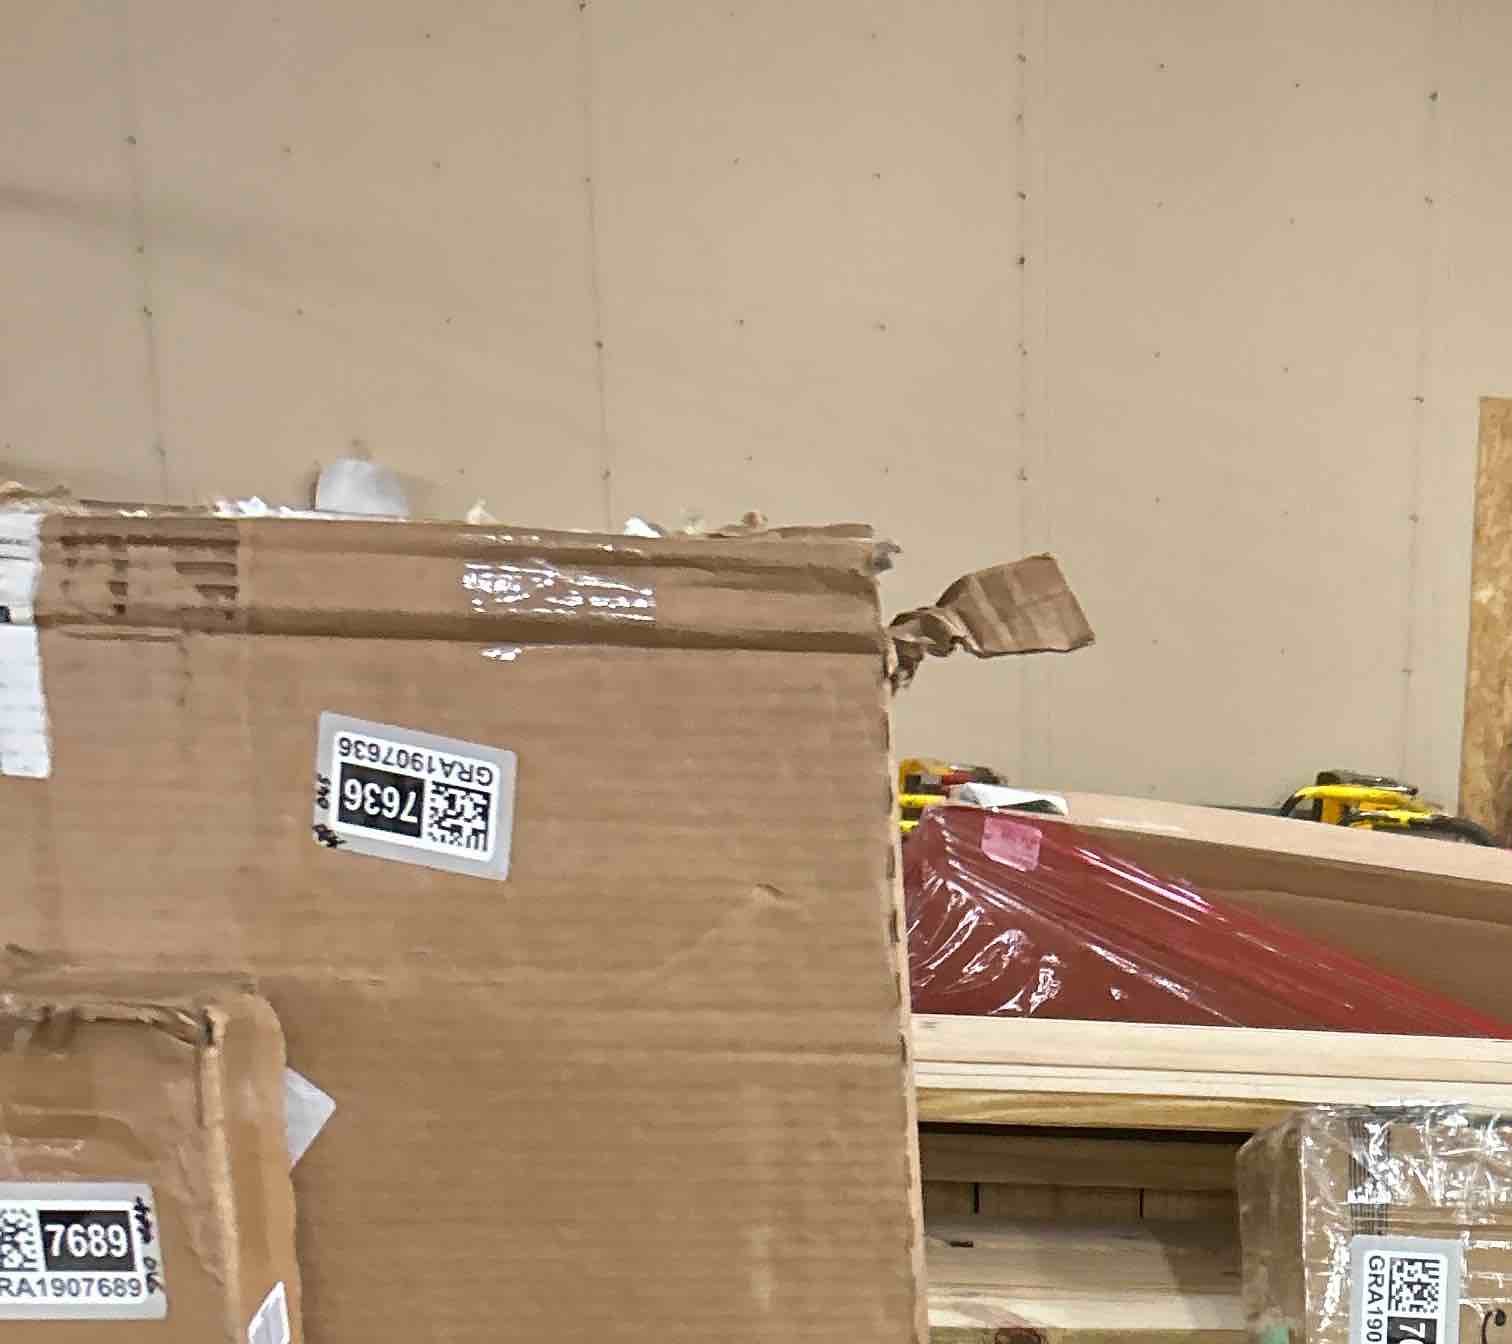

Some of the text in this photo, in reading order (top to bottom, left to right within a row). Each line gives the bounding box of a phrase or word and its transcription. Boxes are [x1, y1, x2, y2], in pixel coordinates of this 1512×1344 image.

[338, 736, 494, 787] GRA1907636
[343, 777, 419, 824] 7636
[44, 1223, 128, 1257] 7689
